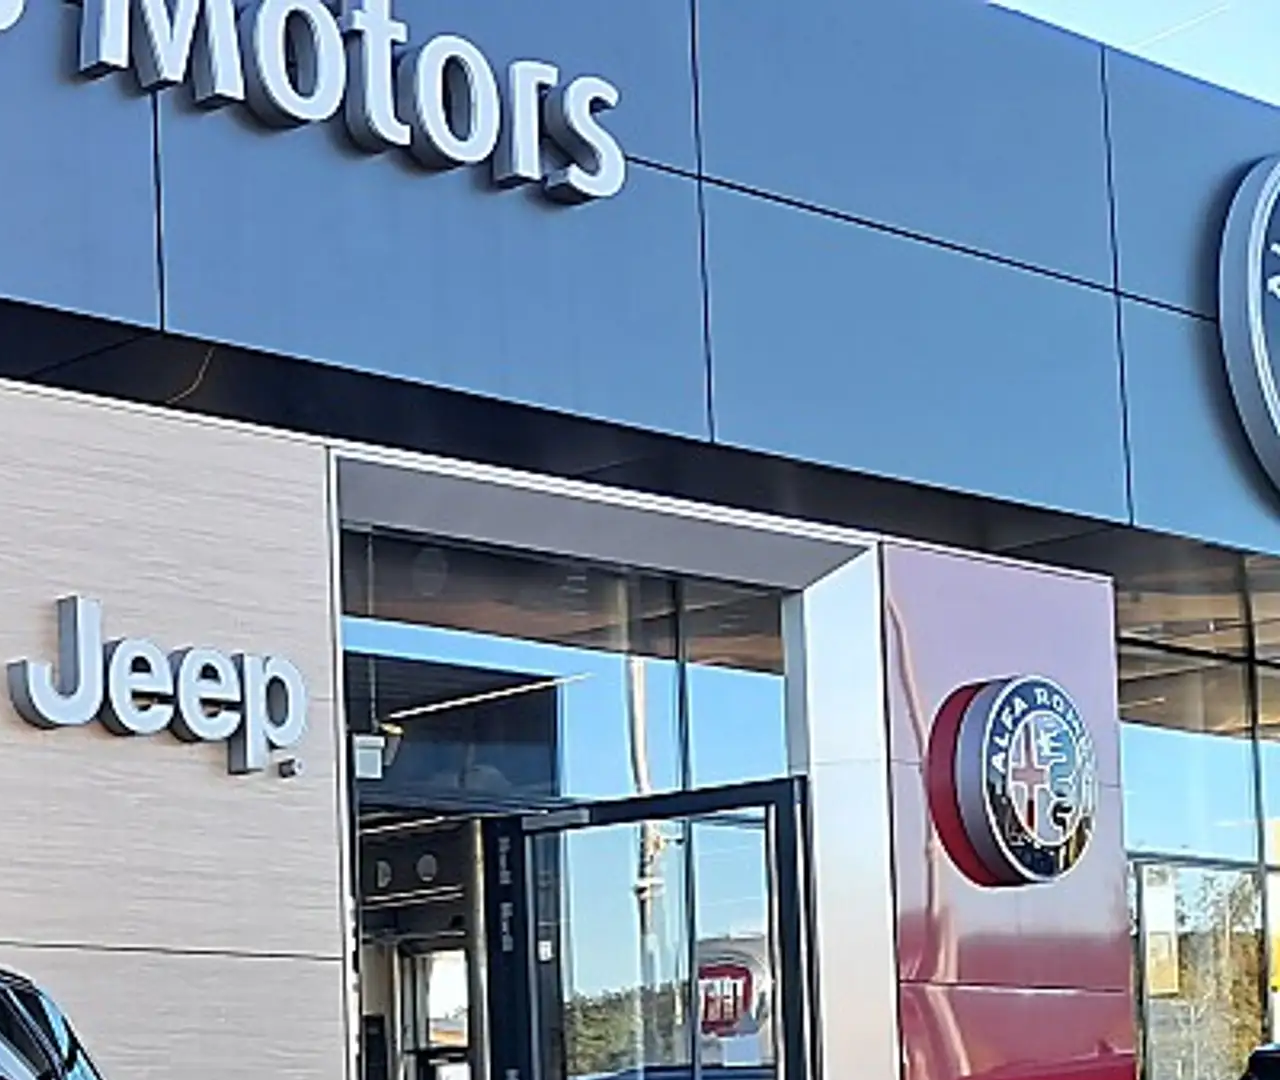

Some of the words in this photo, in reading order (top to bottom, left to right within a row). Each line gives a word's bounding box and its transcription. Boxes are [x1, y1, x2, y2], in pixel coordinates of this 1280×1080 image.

[76, 0, 626, 203] Motors
[6, 595, 306, 775] Jeep
[991, 695, 1028, 774] ALFA
